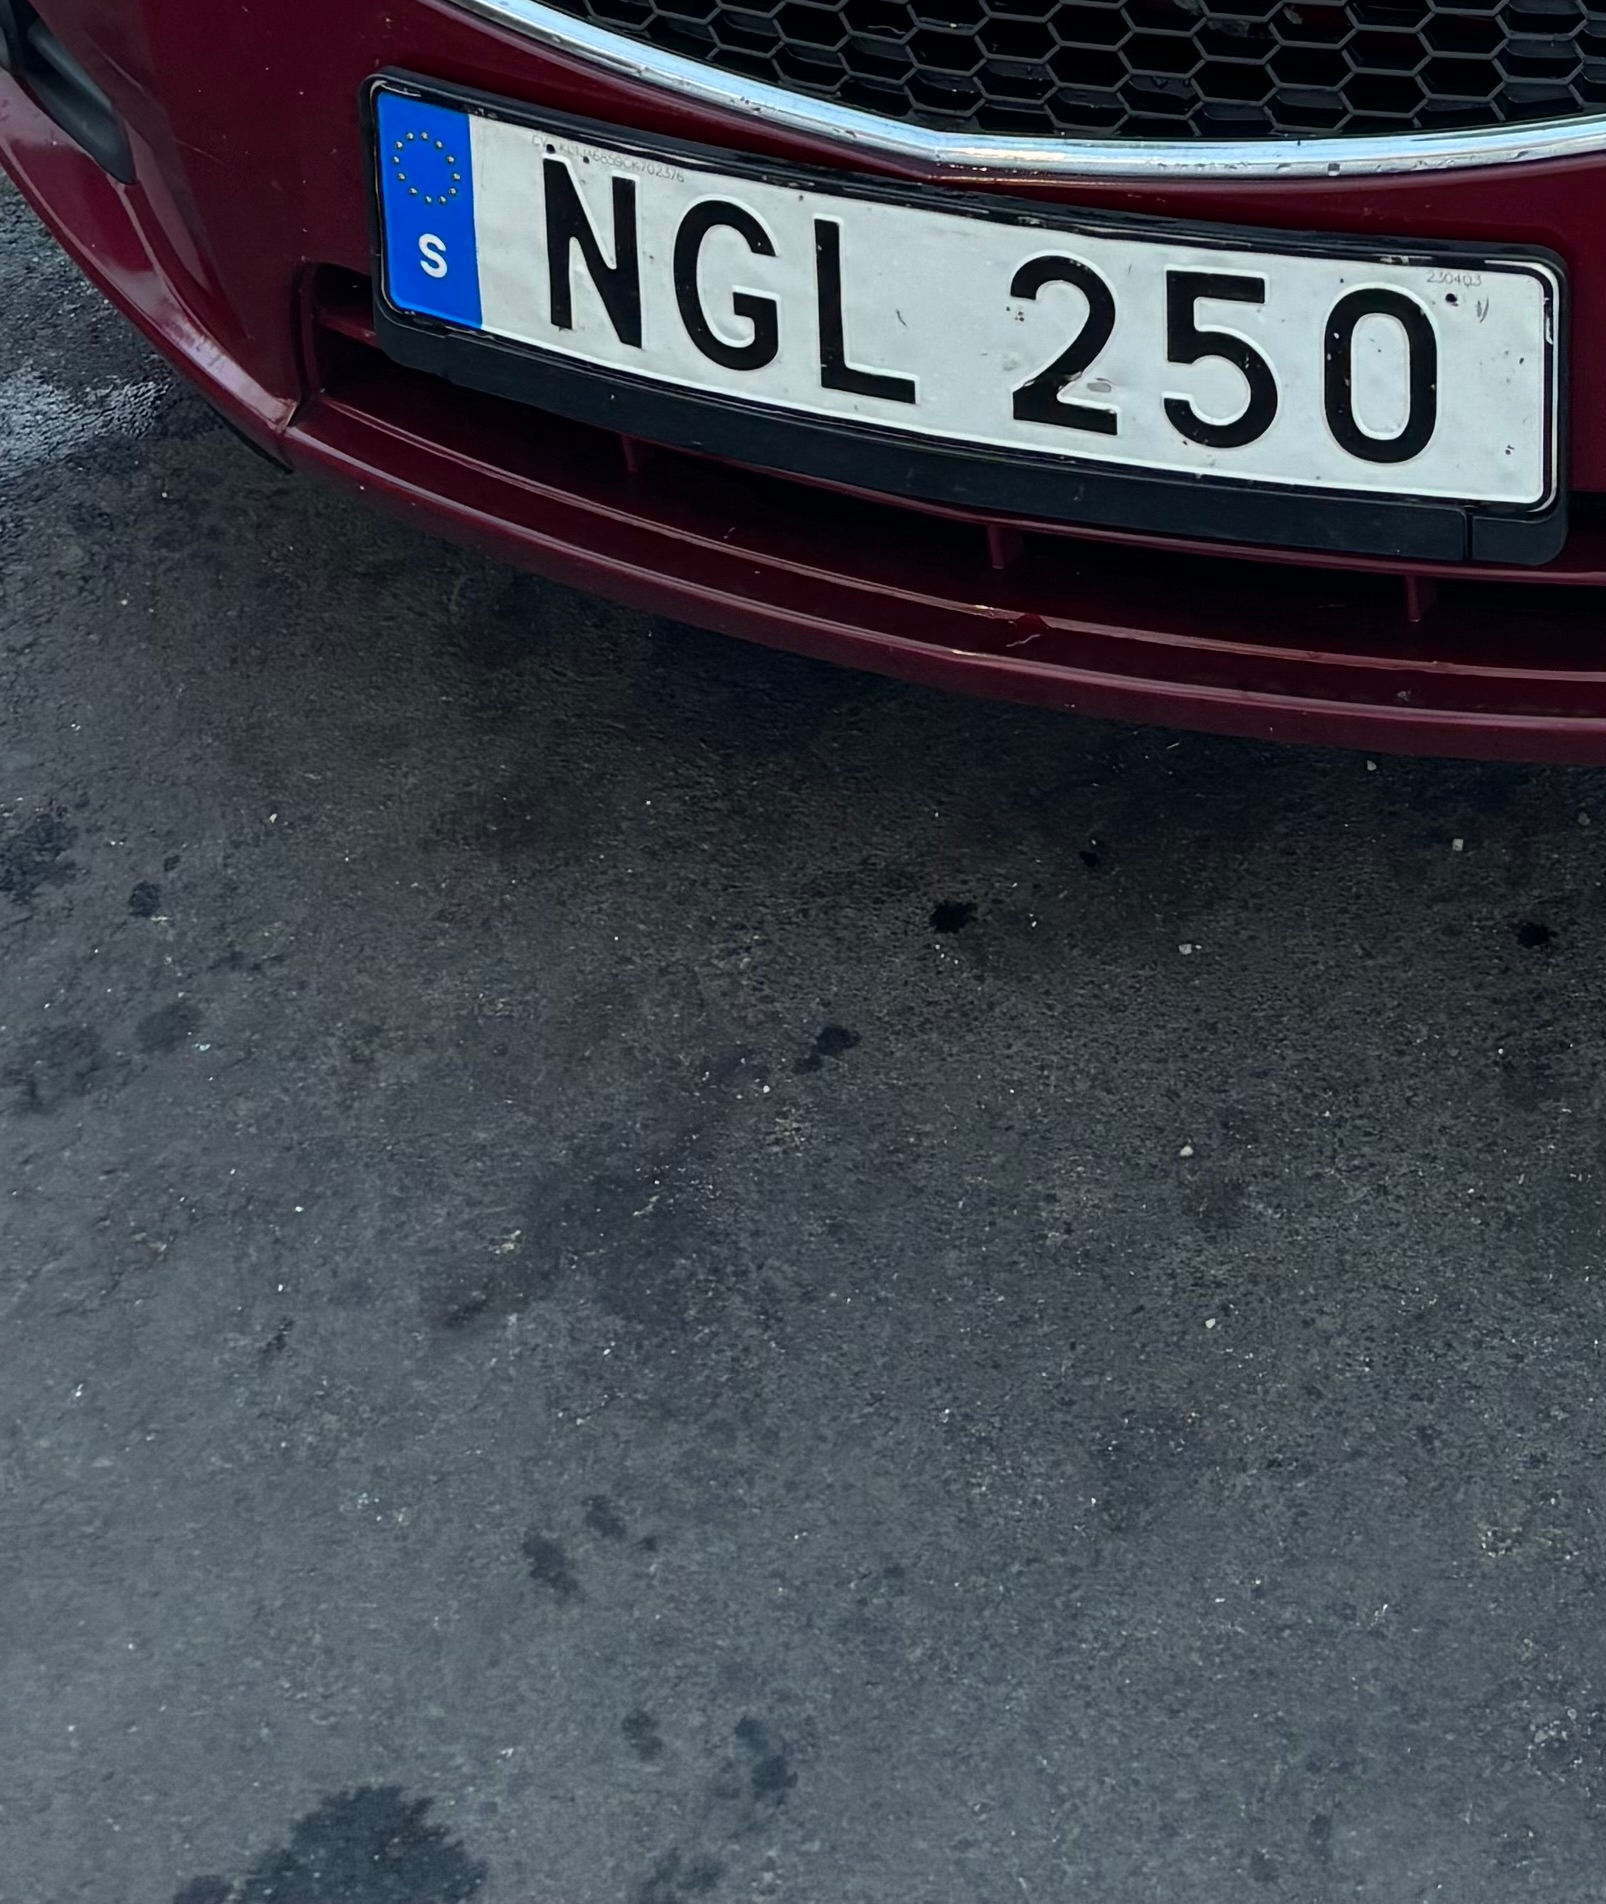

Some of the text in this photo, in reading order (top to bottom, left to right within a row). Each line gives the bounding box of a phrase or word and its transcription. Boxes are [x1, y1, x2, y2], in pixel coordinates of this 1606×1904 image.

[418, 231, 449, 280] S
[541, 155, 1441, 466] NGL 250
